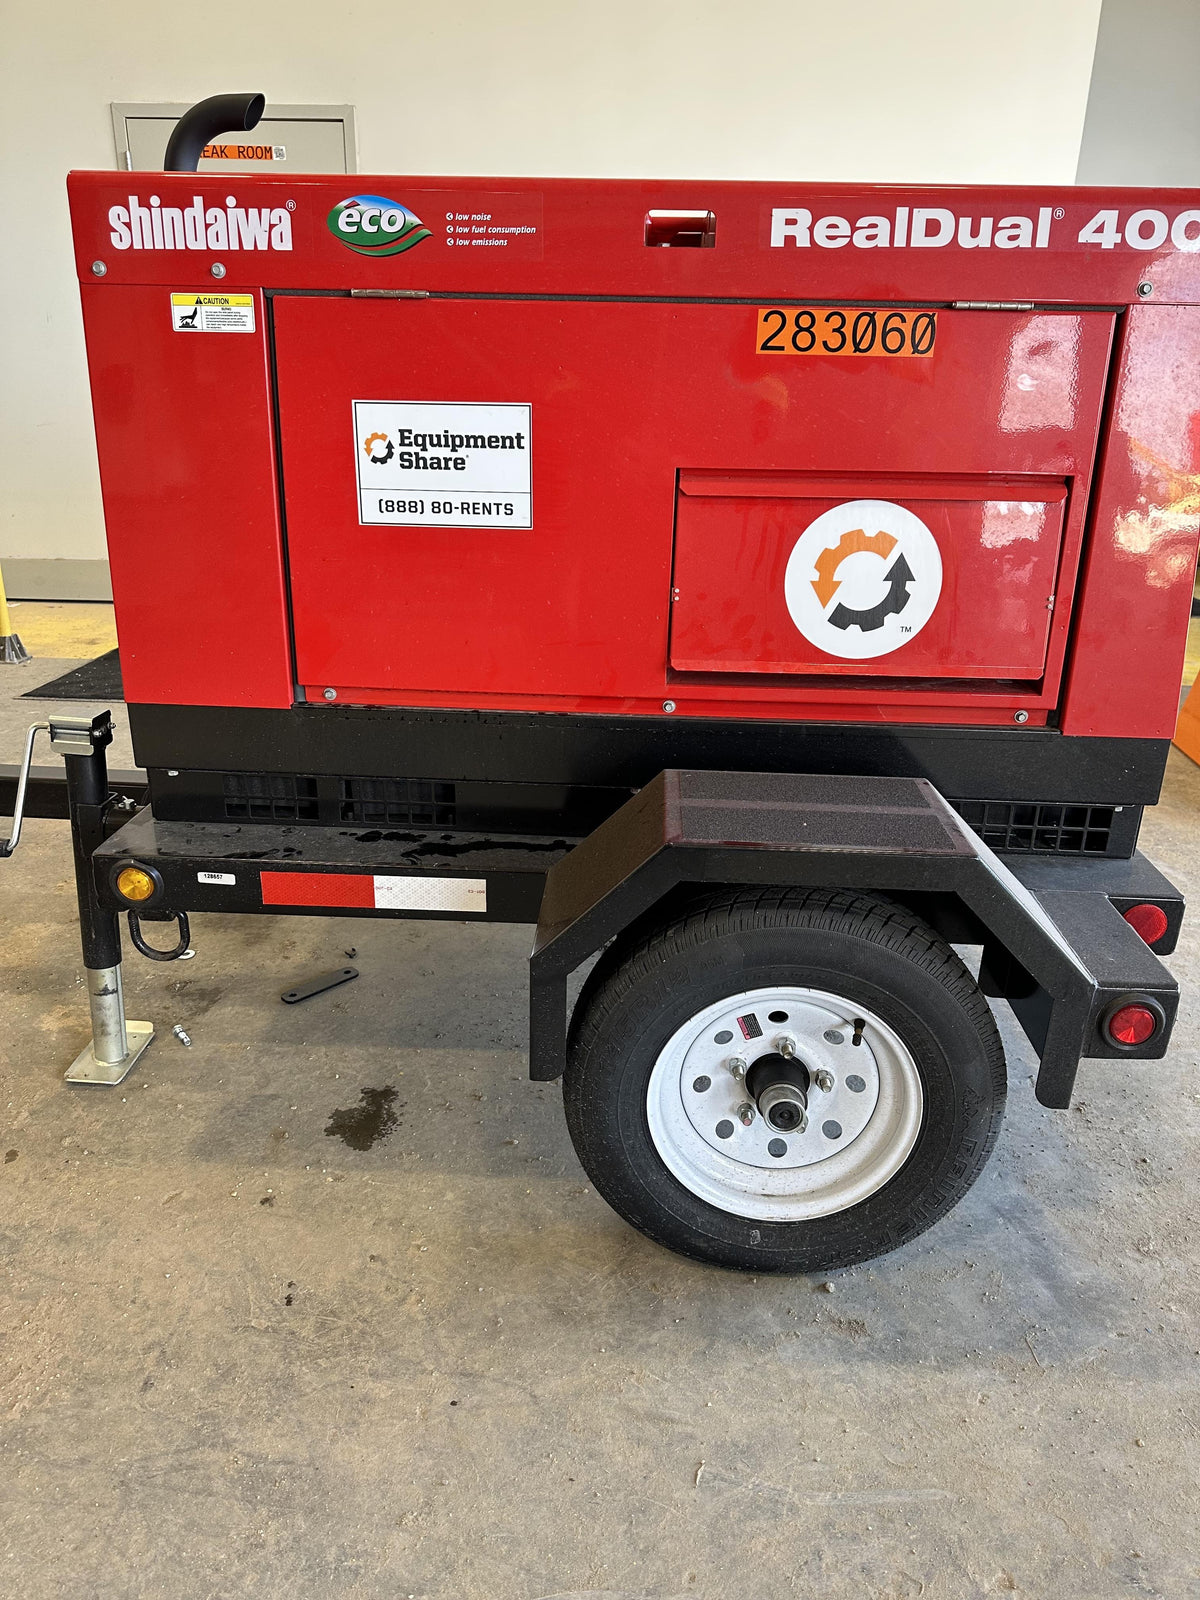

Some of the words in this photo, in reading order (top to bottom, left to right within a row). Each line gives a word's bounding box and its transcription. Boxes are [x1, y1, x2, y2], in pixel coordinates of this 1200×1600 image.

[200, 144, 229, 158] EAK
[238, 145, 273, 160] ROOM
[455, 212, 470, 221] low
[471, 212, 492, 221] noise
[455, 225, 470, 234] low
[471, 225, 487, 234] fuel
[488, 225, 537, 236] consumption
[455, 238, 470, 247] low
[471, 238, 508, 247] emissions
[203, 297, 230, 305] CAUTION
[398, 428, 525, 453] Equipment
[399, 451, 466, 471] Share
[378, 498, 425, 515] (888)
[431, 501, 514, 516] 80-RENTS
